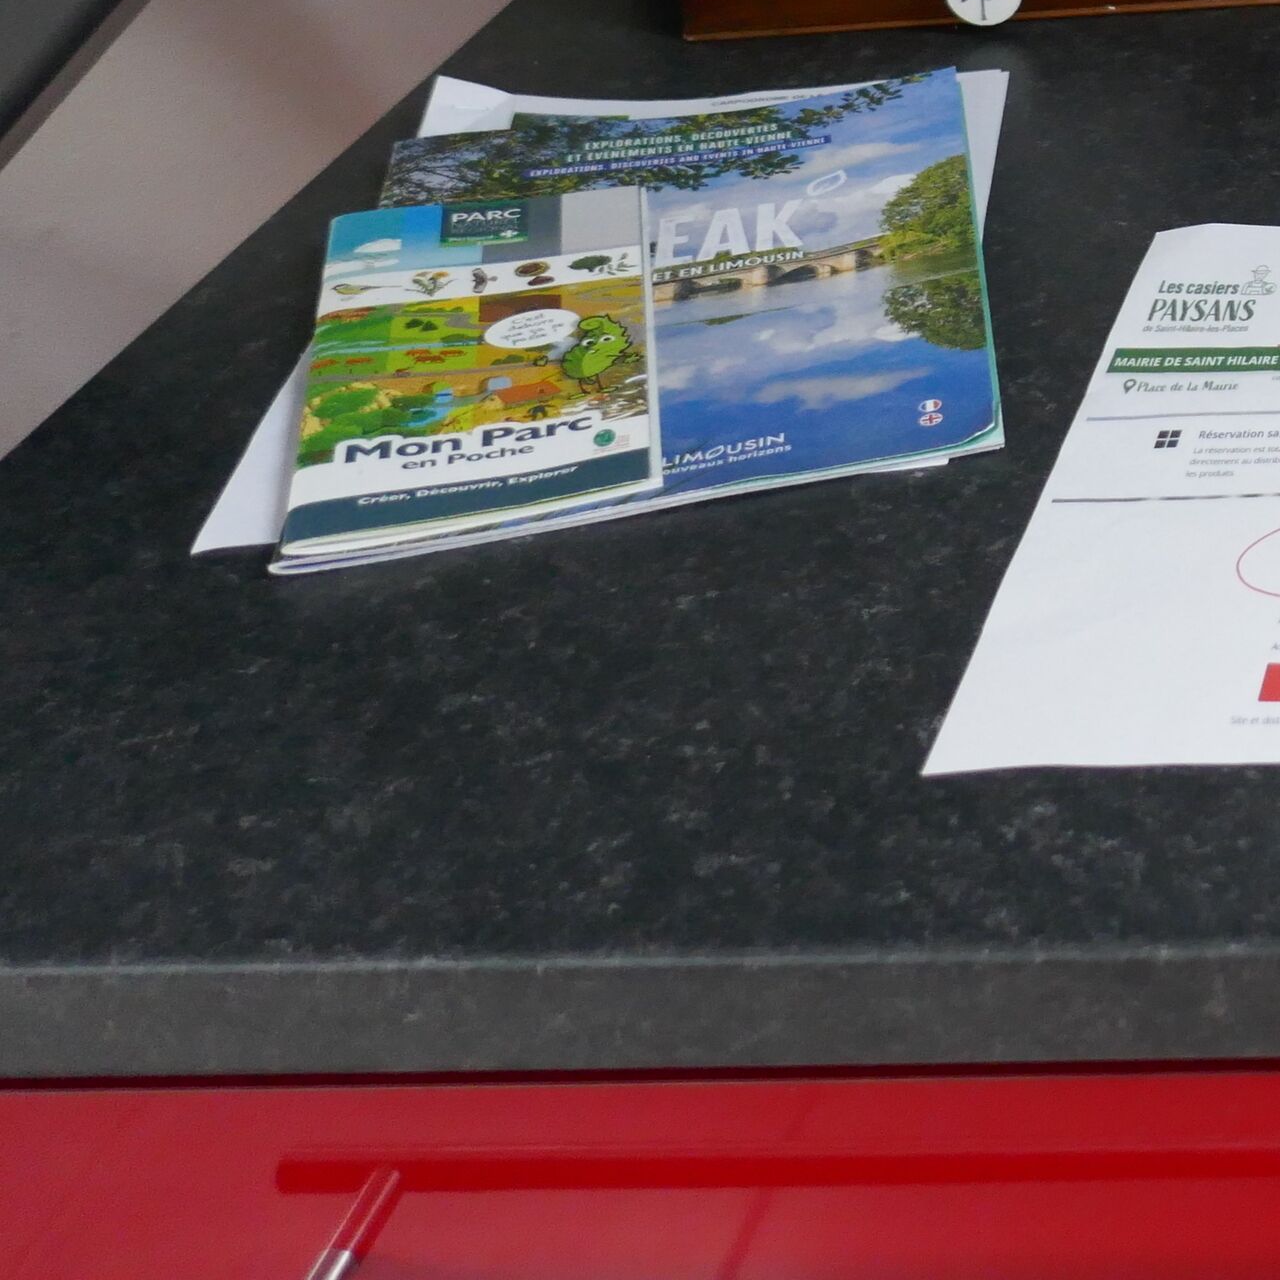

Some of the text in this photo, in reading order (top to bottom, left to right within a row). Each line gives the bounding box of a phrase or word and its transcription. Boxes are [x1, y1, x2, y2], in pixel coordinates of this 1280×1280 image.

[678, 140, 695, 153] EN
[452, 208, 522, 223] PARC
[655, 198, 804, 268] EAK
[652, 250, 804, 282] ET EN LIMOUSIN
[1158, 281, 1239, 294] Les casiers
[1148, 300, 1255, 320] PAYSANS
[1113, 358, 1160, 369] MAIRIE
[1163, 358, 1181, 368] DE
[1183, 357, 1222, 367] SAINT
[1226, 356, 1278, 366] HILAIRE
[1136, 381, 1238, 392] Place de la Mairie
[344, 436, 463, 464] Mon
[481, 415, 594, 448] Parc
[1198, 429, 1264, 439] Réservation
[401, 443, 535, 470] en Poche
[662, 432, 786, 468] LIMOUSIN
[663, 443, 793, 476] ouveaux horizons
[508, 465, 579, 486] Explorer
